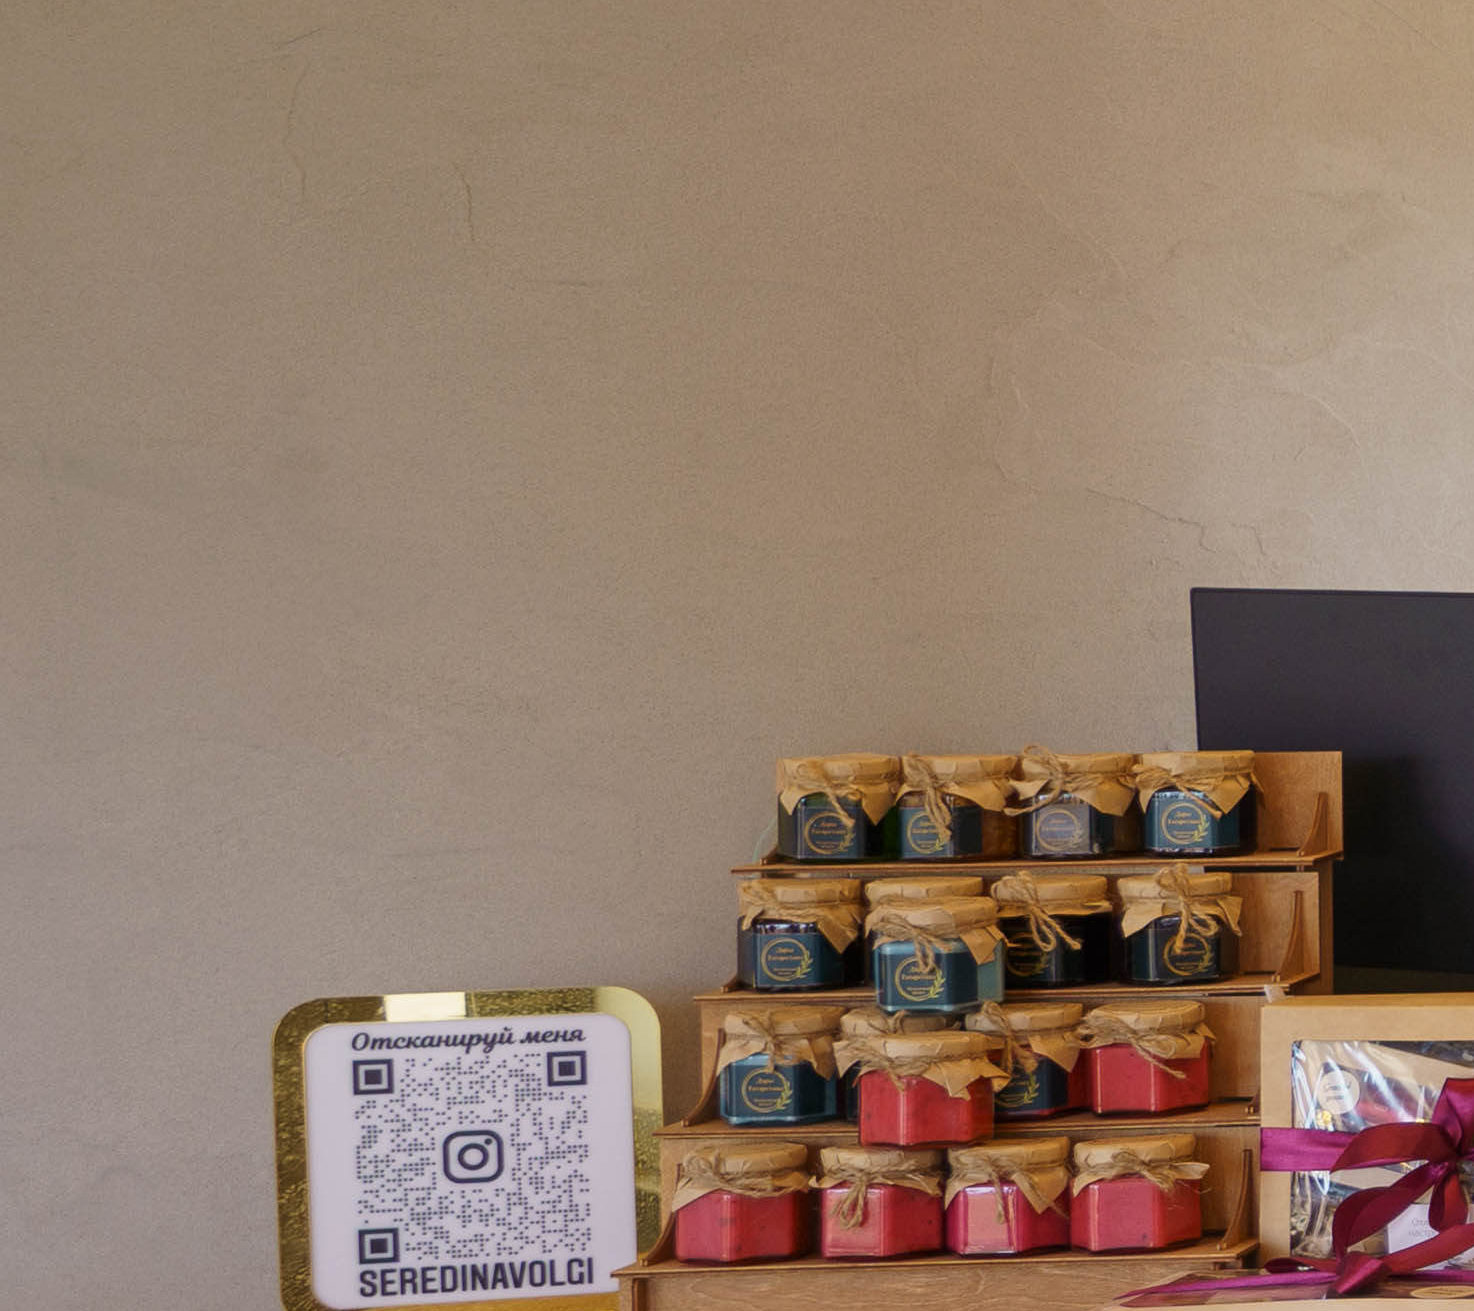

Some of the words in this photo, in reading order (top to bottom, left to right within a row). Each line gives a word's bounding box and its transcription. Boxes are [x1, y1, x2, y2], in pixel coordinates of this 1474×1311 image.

[351, 1027, 515, 1054] Отсканируй
[520, 1026, 586, 1045] меня
[359, 1257, 594, 1298] SEREDINAVOLGI
